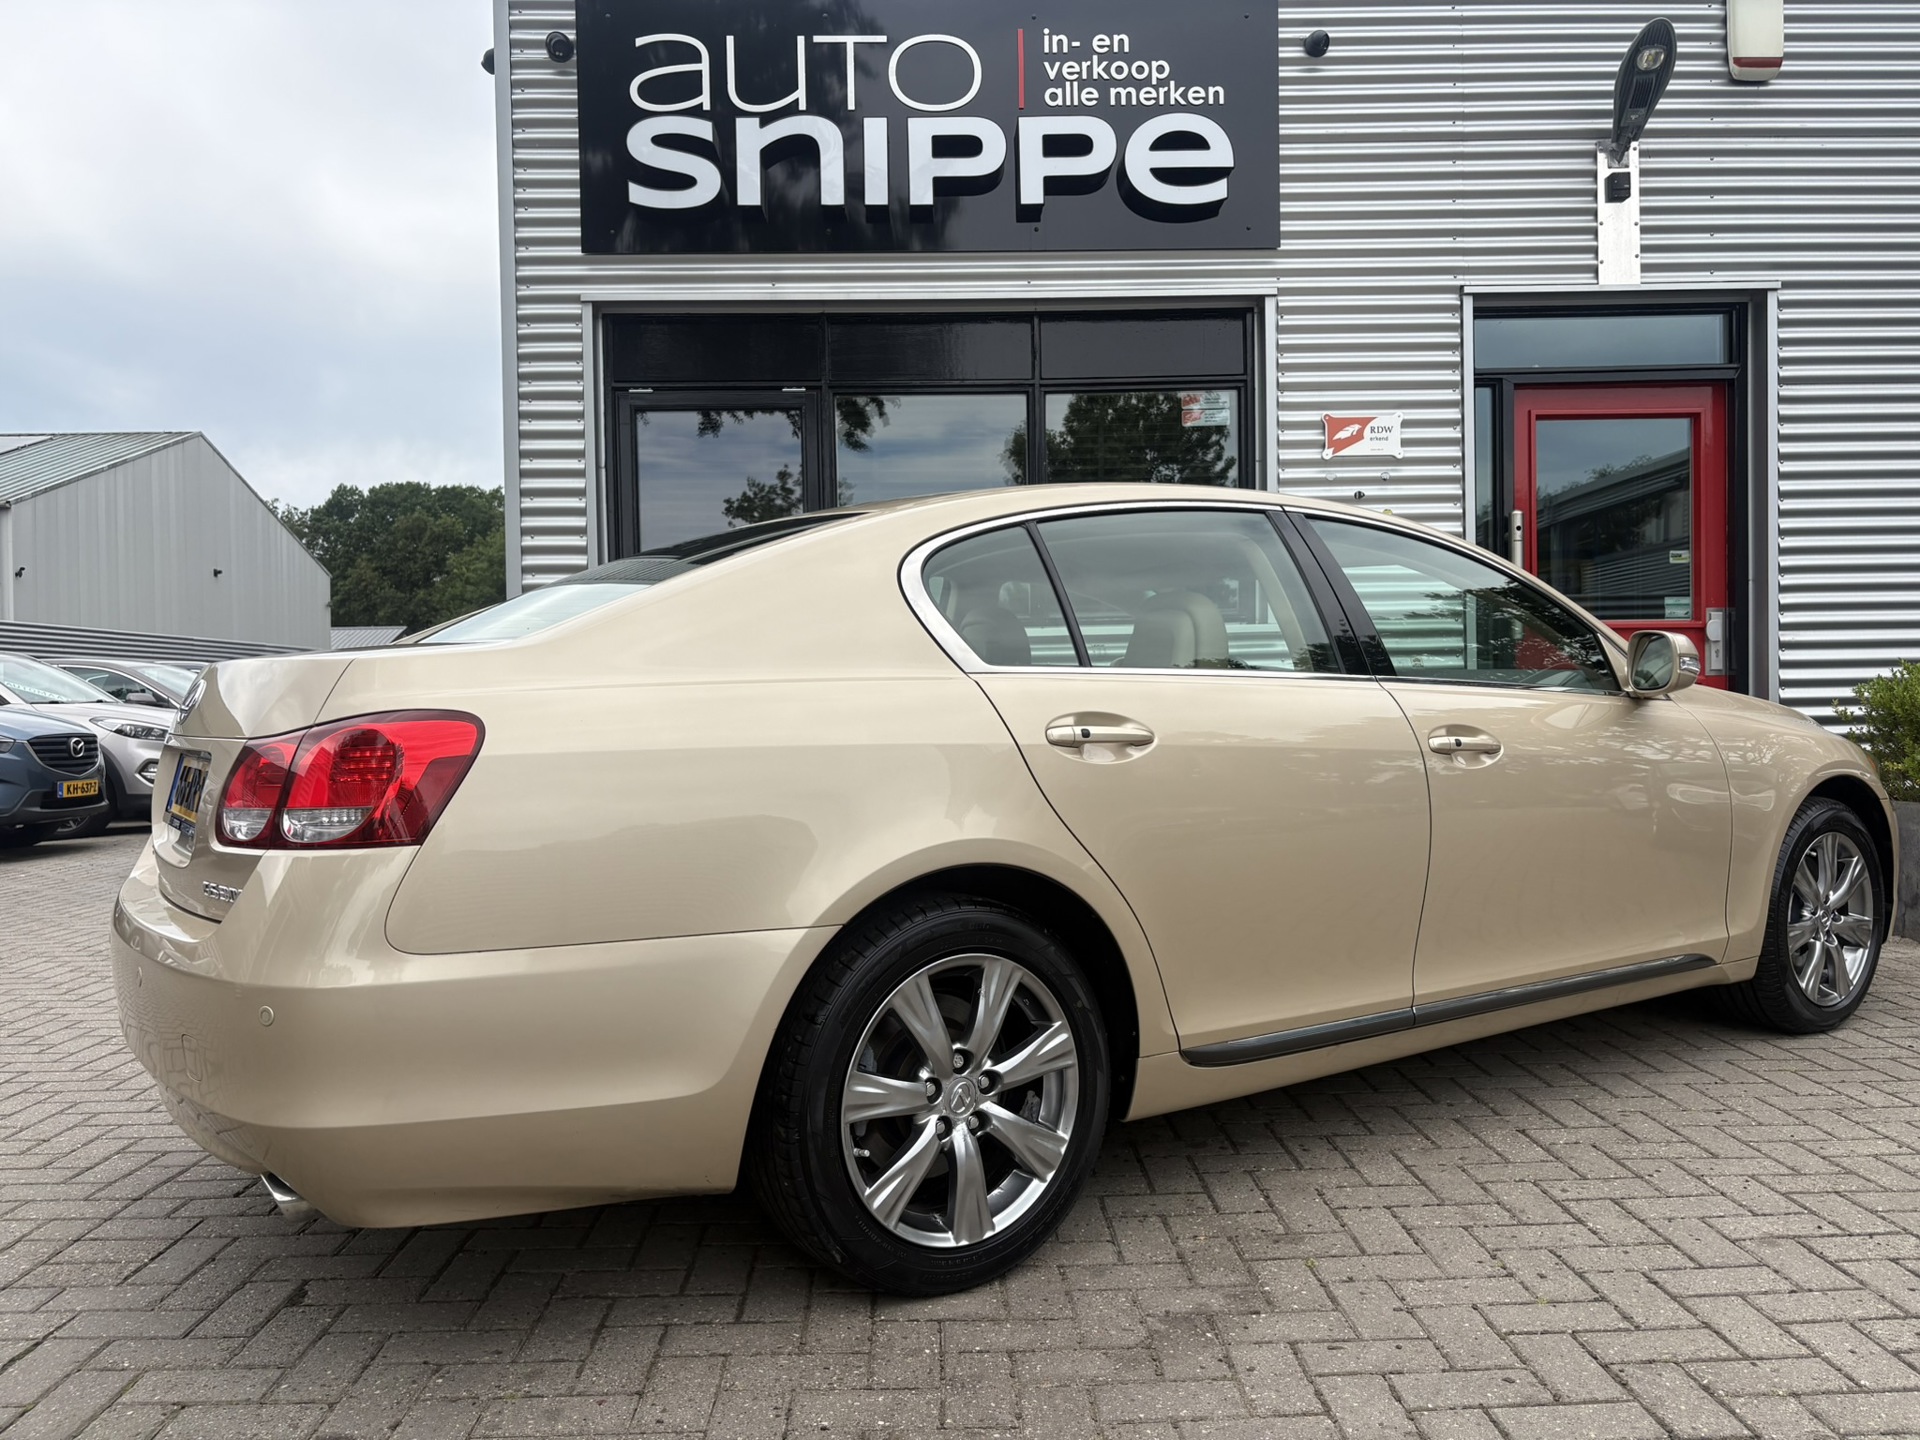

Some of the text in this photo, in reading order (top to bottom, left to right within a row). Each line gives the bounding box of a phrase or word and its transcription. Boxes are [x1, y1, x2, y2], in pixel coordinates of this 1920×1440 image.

[1043, 28, 1130, 55] in- en
[1043, 58, 1171, 86] verkoop
[1043, 81, 1225, 107] alle merken
[1369, 425, 1394, 434] RDW
